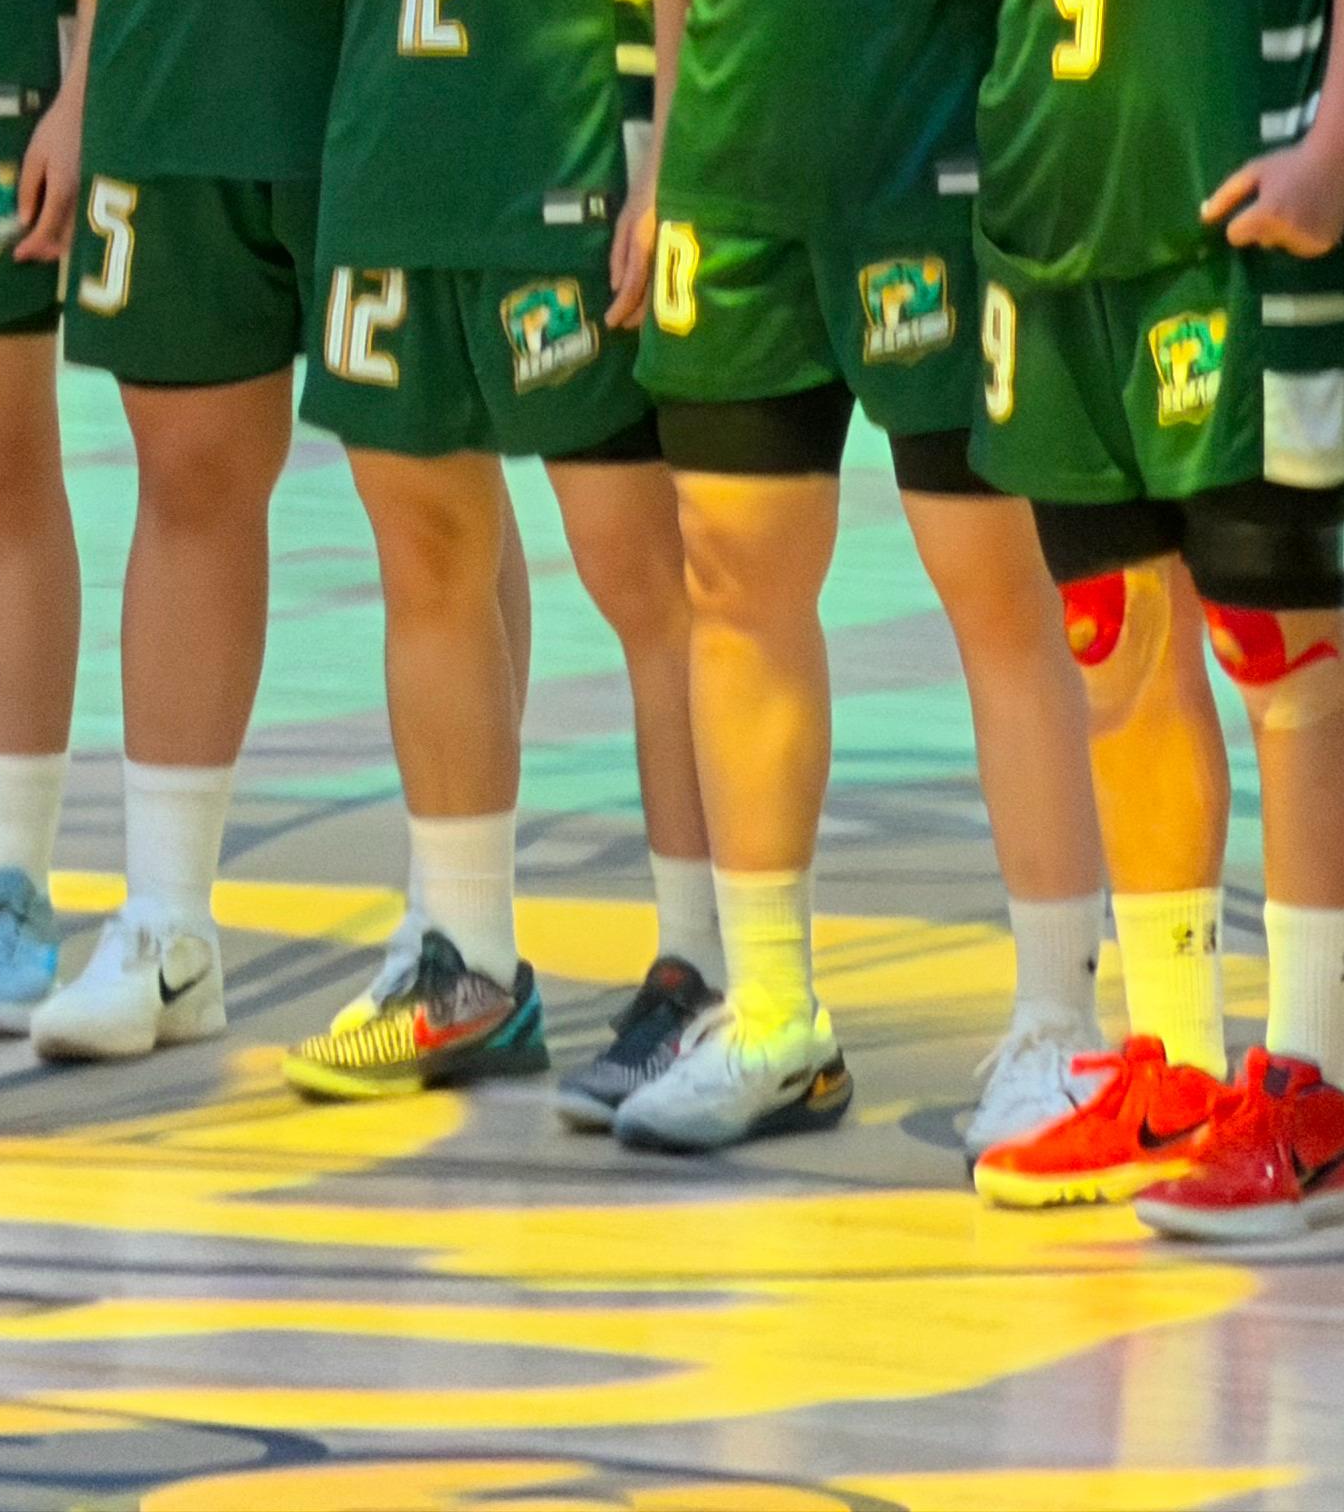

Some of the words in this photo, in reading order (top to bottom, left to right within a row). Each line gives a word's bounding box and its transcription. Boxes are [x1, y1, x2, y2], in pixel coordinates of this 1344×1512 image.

[78, 173, 138, 317] 5
[324, 265, 407, 387] 12
[982, 282, 1017, 425] 9
